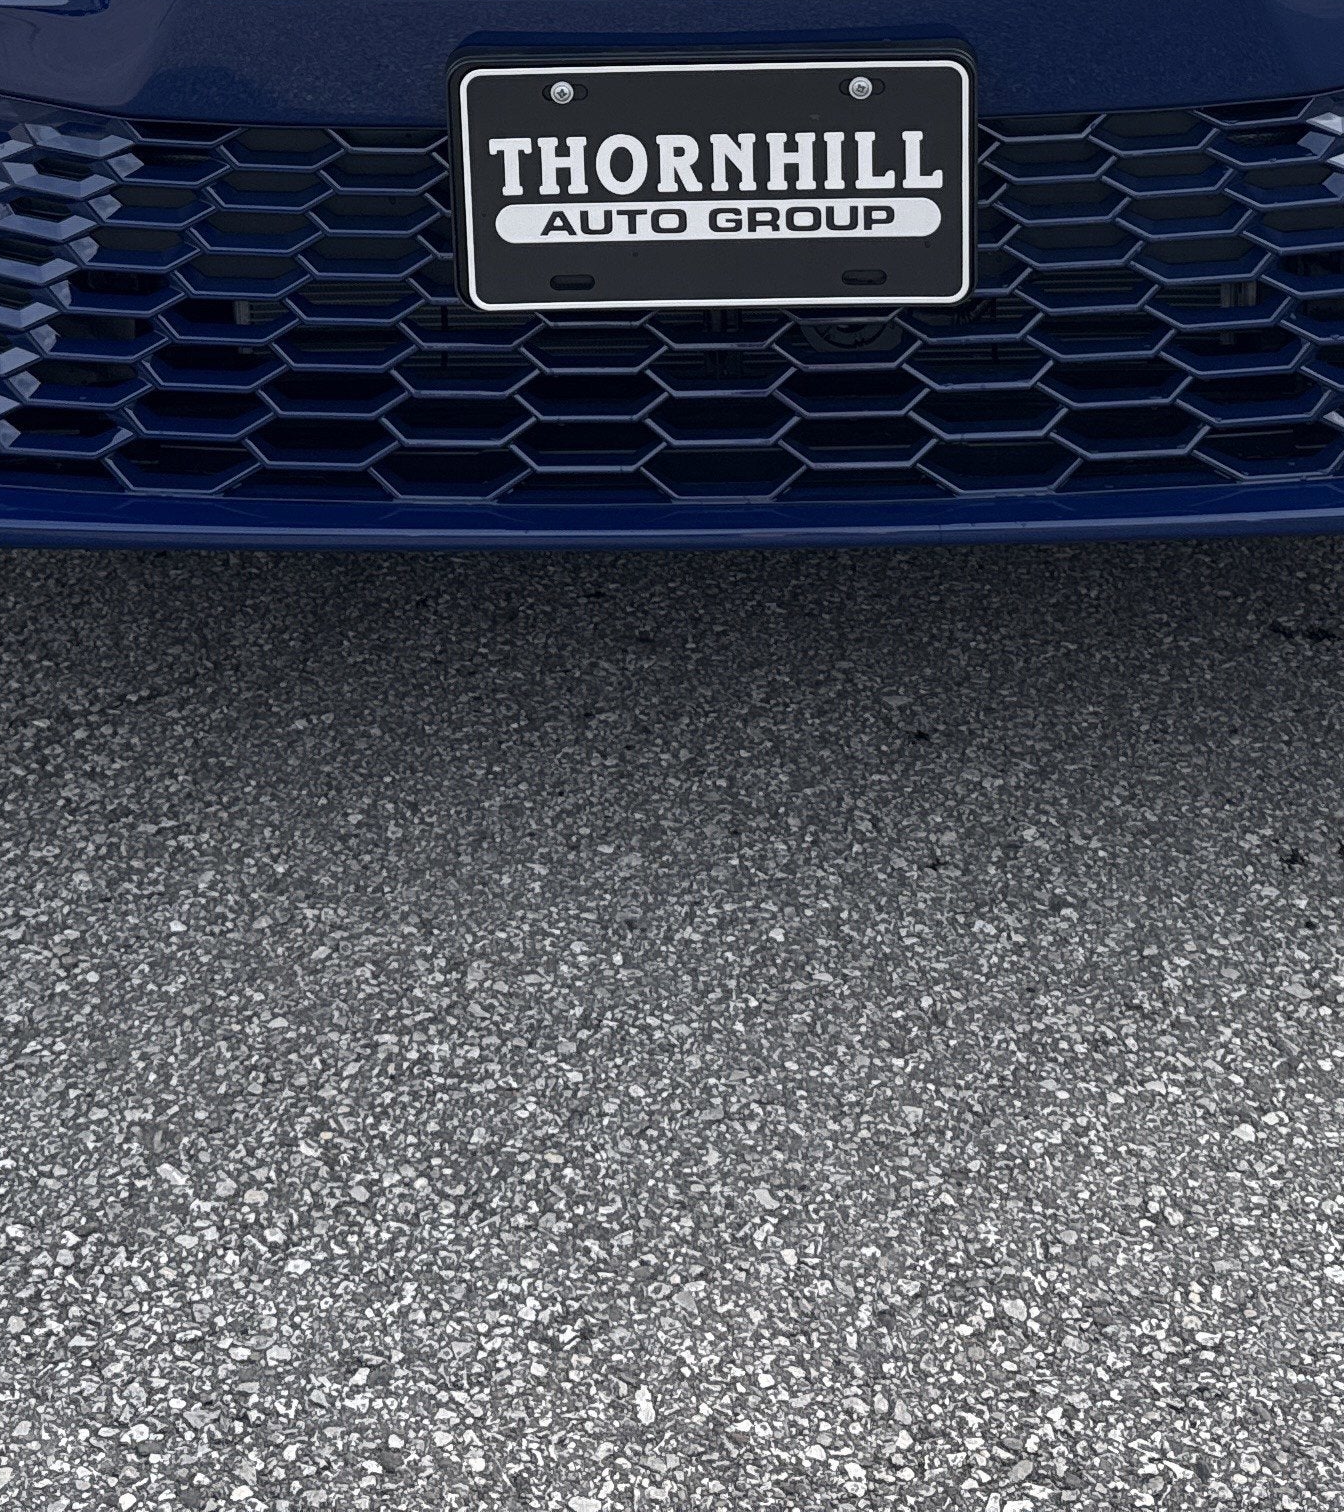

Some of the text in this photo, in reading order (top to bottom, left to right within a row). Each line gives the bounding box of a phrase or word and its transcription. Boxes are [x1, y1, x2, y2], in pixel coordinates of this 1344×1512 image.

[488, 130, 943, 196] THORNHILL
[540, 205, 895, 237] AUTO GROUP
